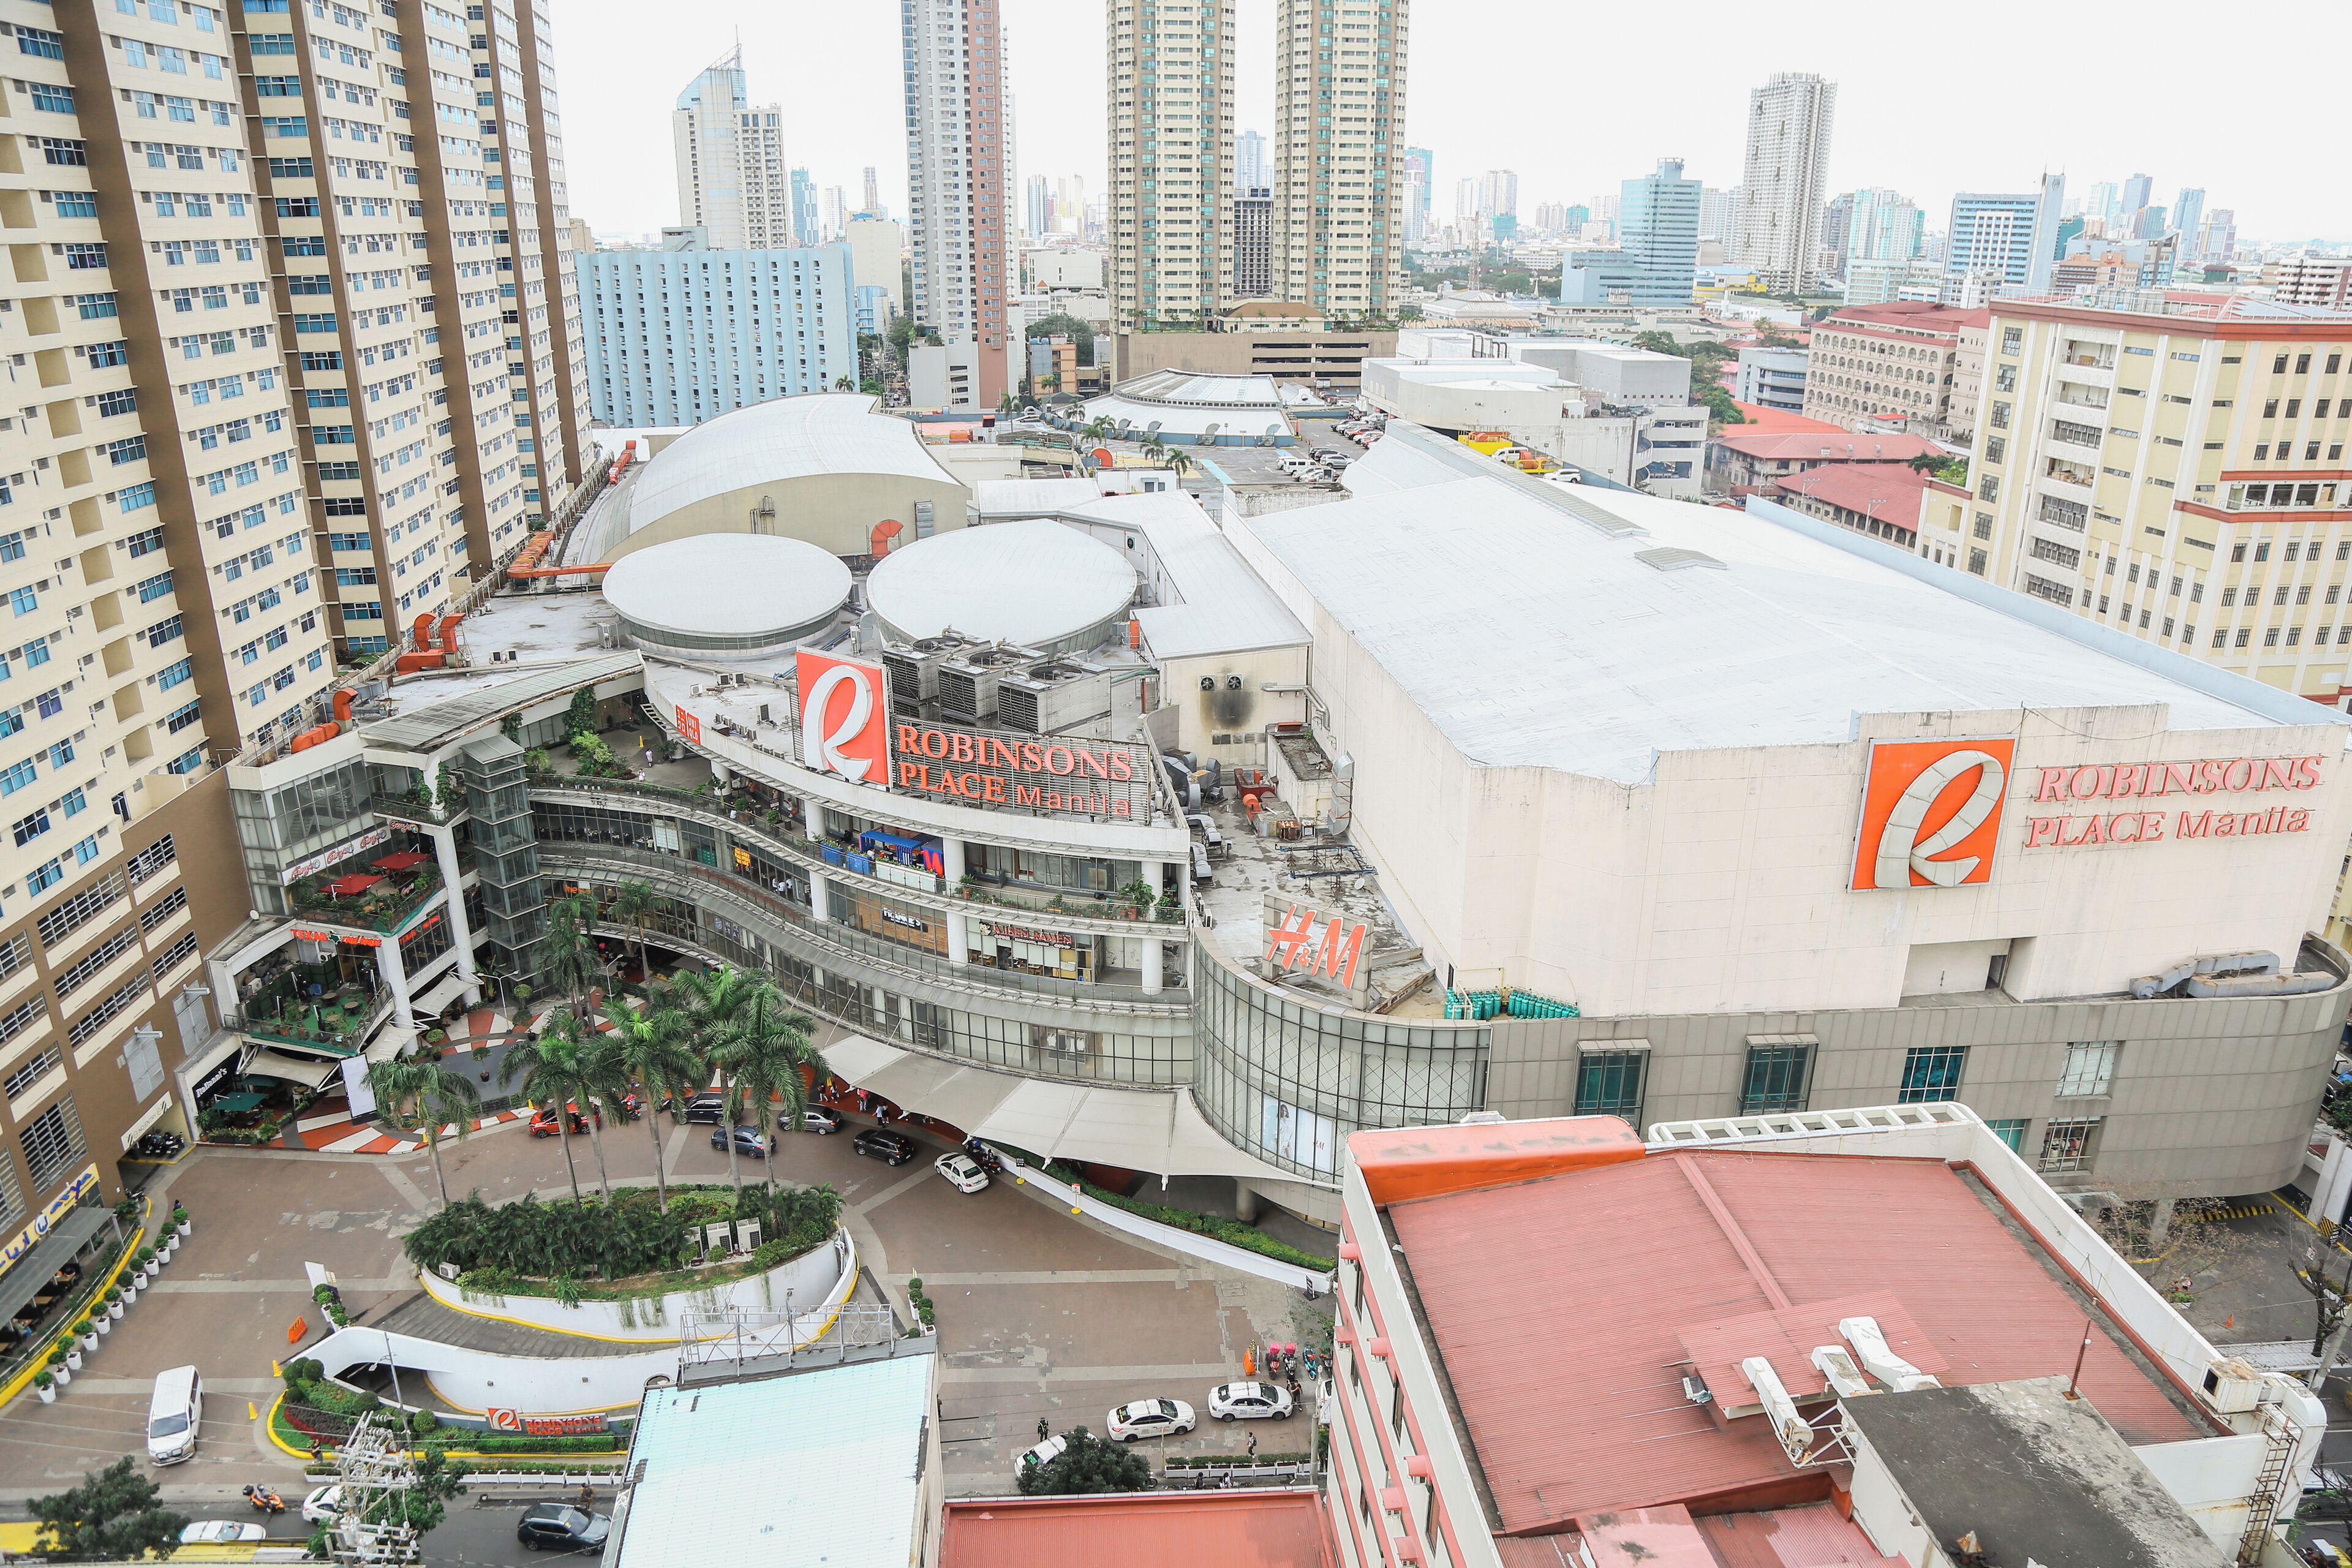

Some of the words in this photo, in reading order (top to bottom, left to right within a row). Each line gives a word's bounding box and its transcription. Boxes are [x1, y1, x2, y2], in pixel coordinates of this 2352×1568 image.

[896, 725, 1132, 782] ROBINSONS
[898, 761, 1006, 803] PLACE
[1017, 785, 1131, 816] Manila
[2034, 756, 2324, 803] ROBINSONS
[2024, 812, 2167, 848] PLACE
[2176, 805, 2310, 840] Manila
[290, 929, 328, 941] TEXAS
[1033, 930, 1072, 944] RAMEN
[1267, 903, 1368, 990] H&M
[525, 1415, 601, 1428] ROBINSONS
